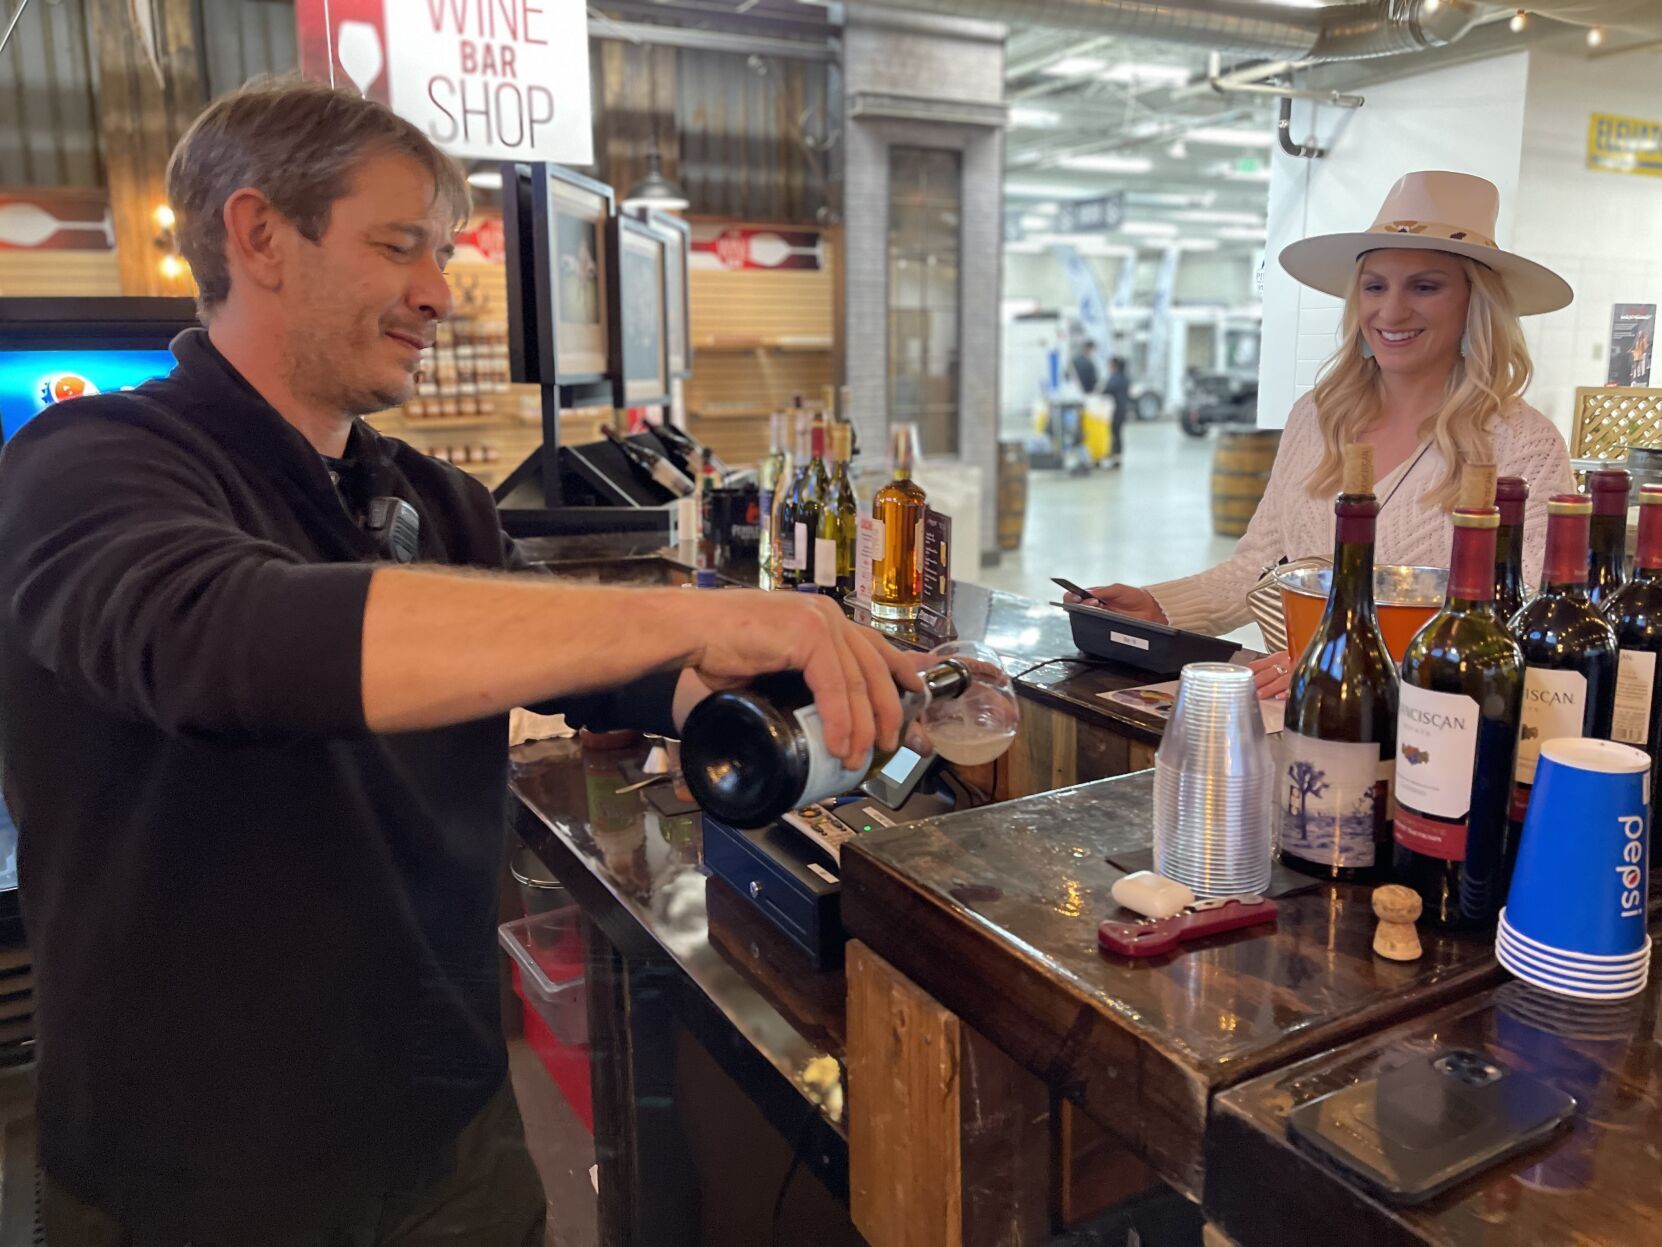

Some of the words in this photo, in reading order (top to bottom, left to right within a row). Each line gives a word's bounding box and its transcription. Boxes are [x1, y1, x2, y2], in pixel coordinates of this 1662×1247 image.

[427, 0, 548, 45] WINE
[460, 40, 517, 78] BAR
[428, 75, 554, 148] SHOP
[1615, 815, 1644, 917] pepsi
